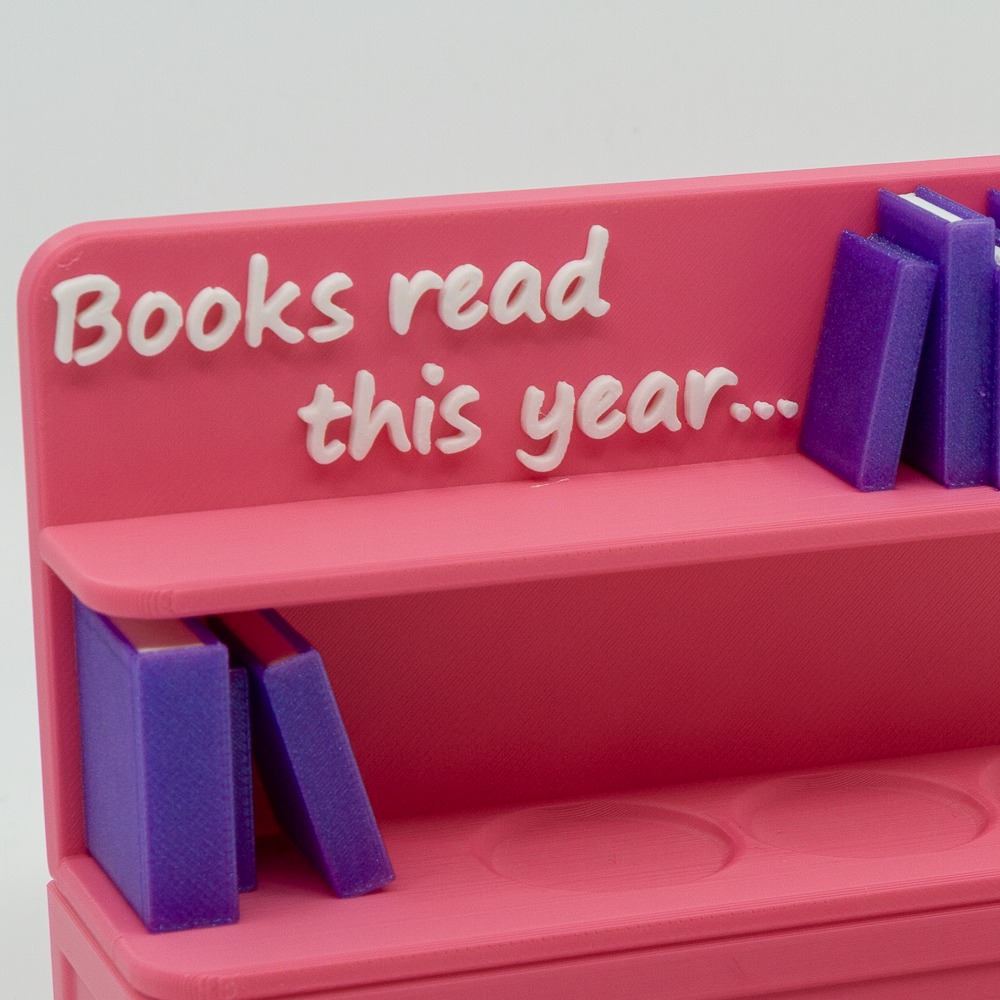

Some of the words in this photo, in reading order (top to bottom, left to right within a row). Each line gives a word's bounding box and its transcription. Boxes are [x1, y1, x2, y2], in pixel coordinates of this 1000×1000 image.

[51, 252, 355, 366] Books
[388, 224, 611, 336] read
[297, 362, 482, 465] this
[515, 366, 799, 473] year...
